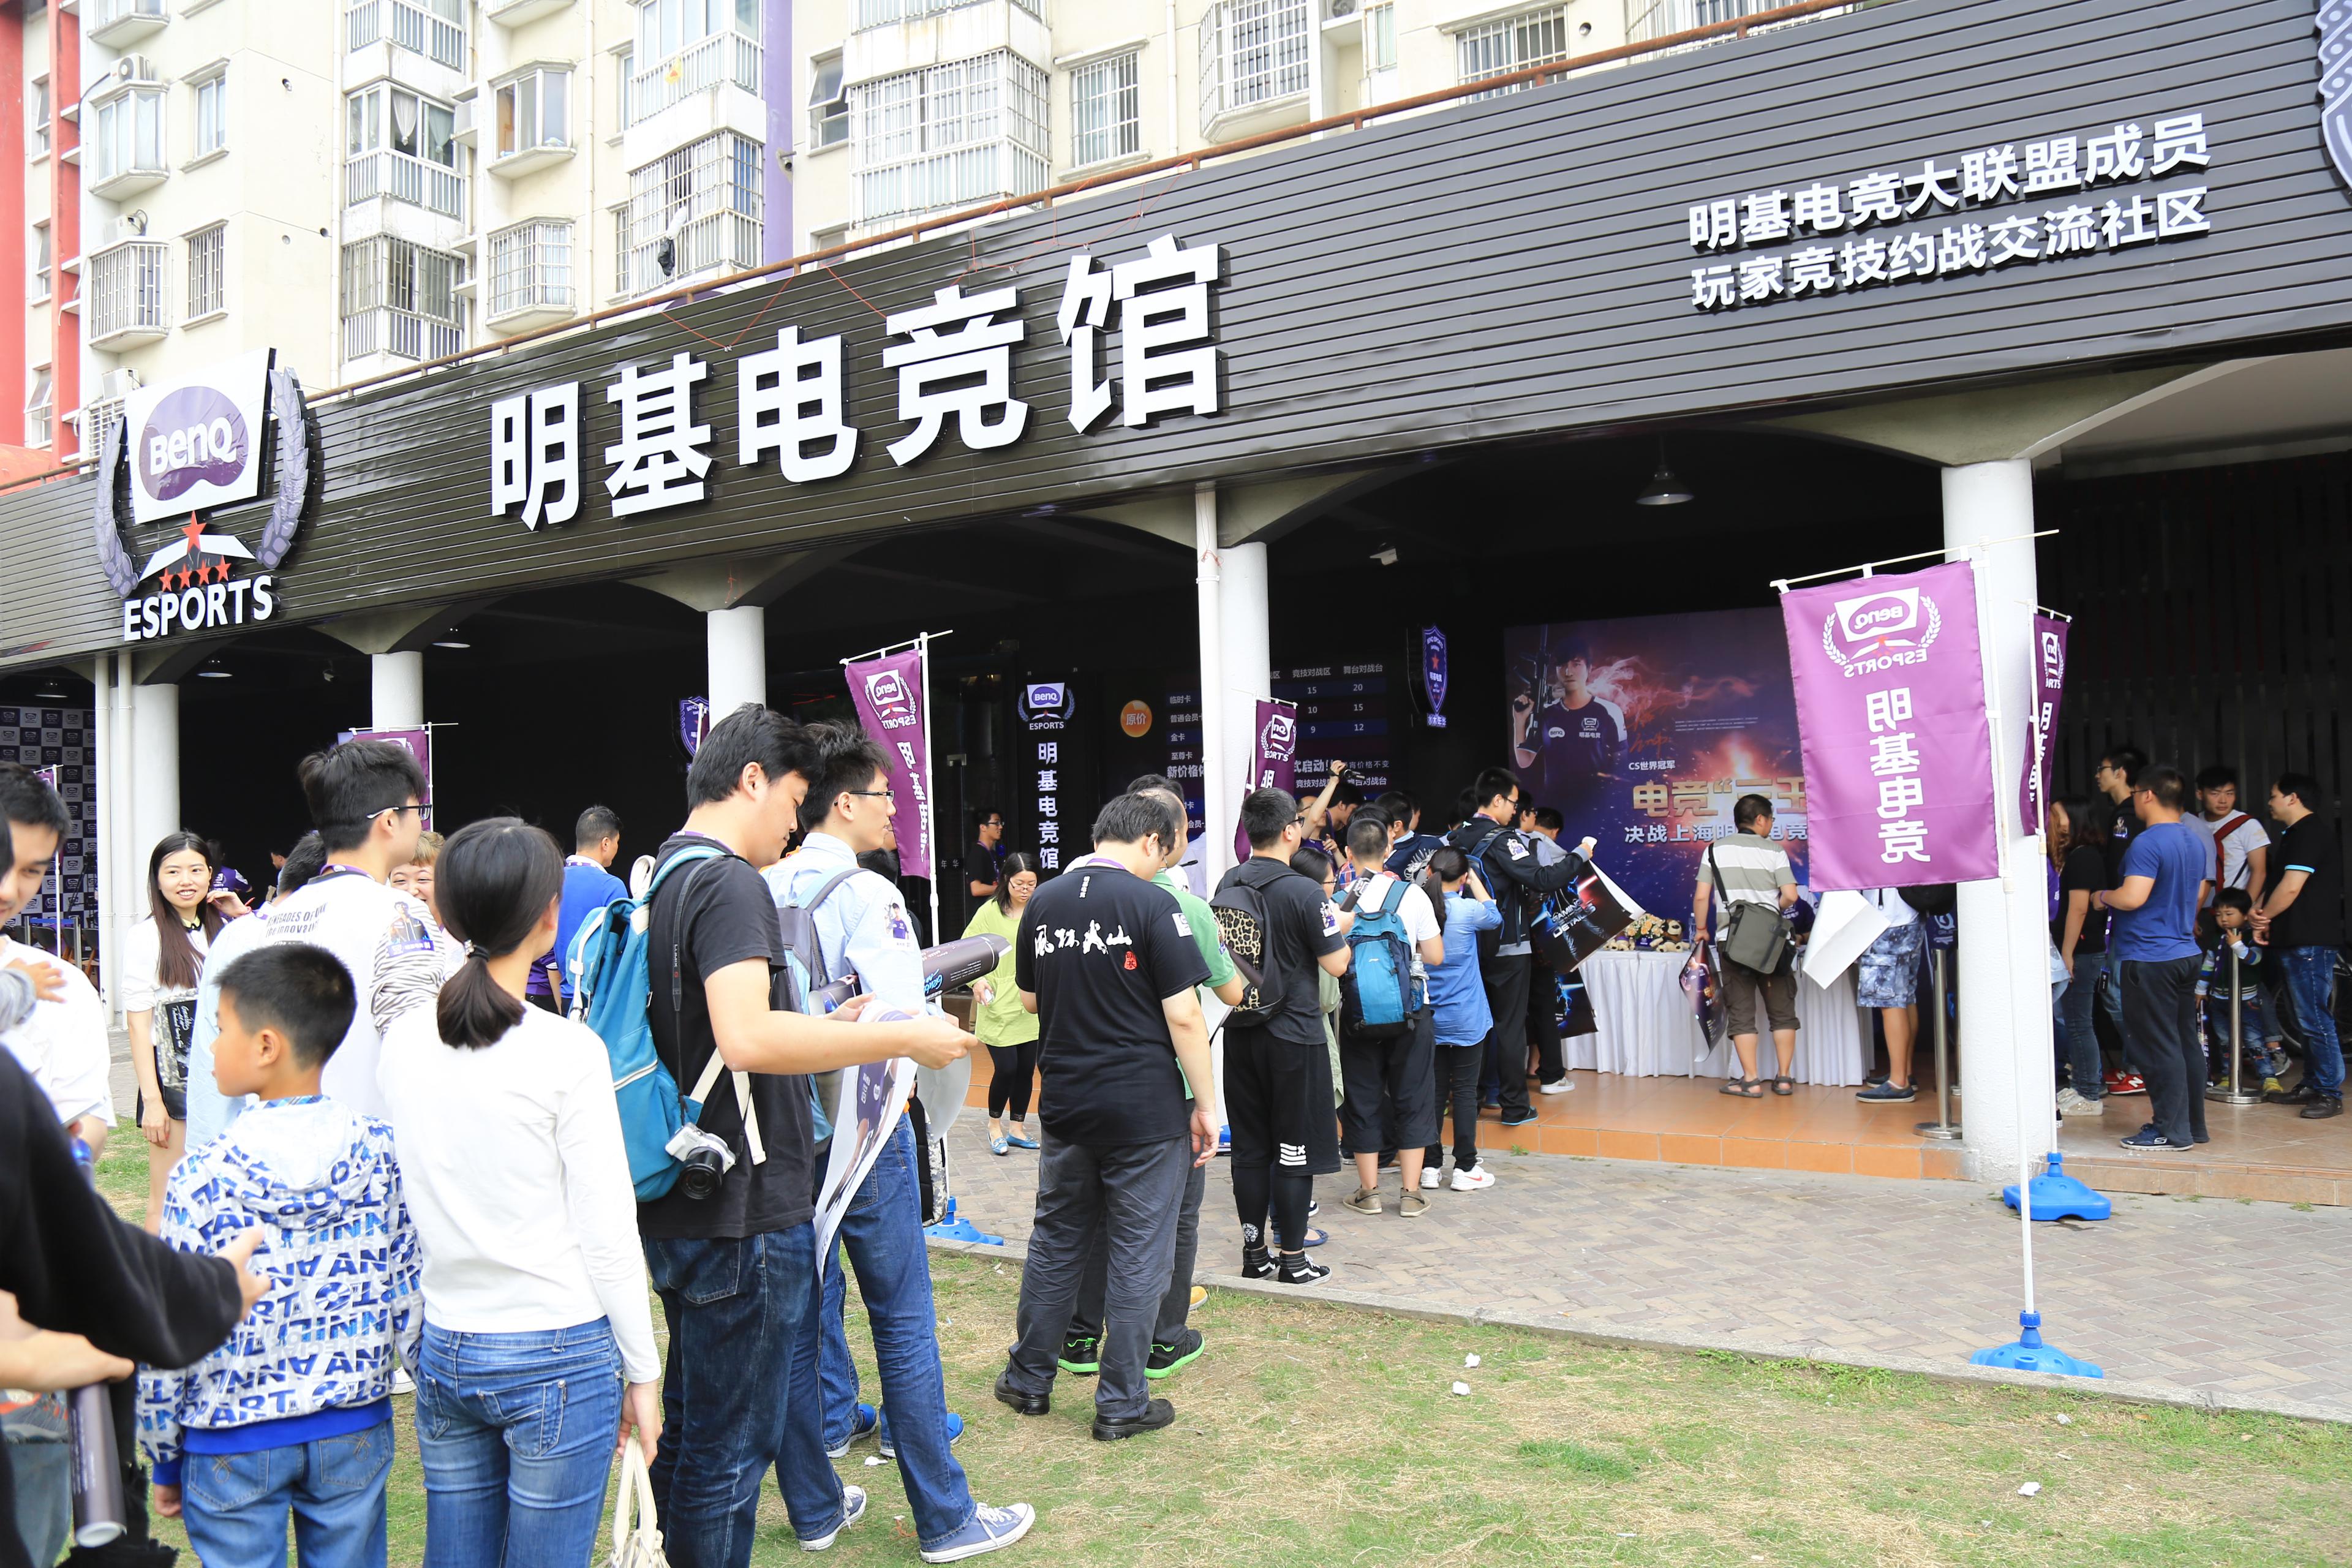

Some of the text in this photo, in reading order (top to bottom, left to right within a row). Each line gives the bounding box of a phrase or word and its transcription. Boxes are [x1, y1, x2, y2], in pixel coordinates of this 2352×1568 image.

[1688, 113, 2211, 251] 明基电竞大联盟成员
[1691, 186, 2211, 309] 玩家竞技约战交流社区
[491, 233, 1220, 532] 明基电竞馆
[149, 417, 238, 476] BenQ
[124, 575, 274, 642] ESPORTS
[1035, 692, 1058, 701] BenQ
[1170, 695, 1191, 704] 临时卡
[1029, 722, 1065, 730] ESPORTS
[1126, 713, 1147, 726] 原价
[1170, 733, 1185, 742] 金卡
[1171, 752, 1193, 760] 至尊卡
[1629, 760, 1676, 771] CS世界冠军
[1038, 741, 1060, 870] 明基电竞馆
[1624, 824, 1807, 844] 决战上海明电竞
